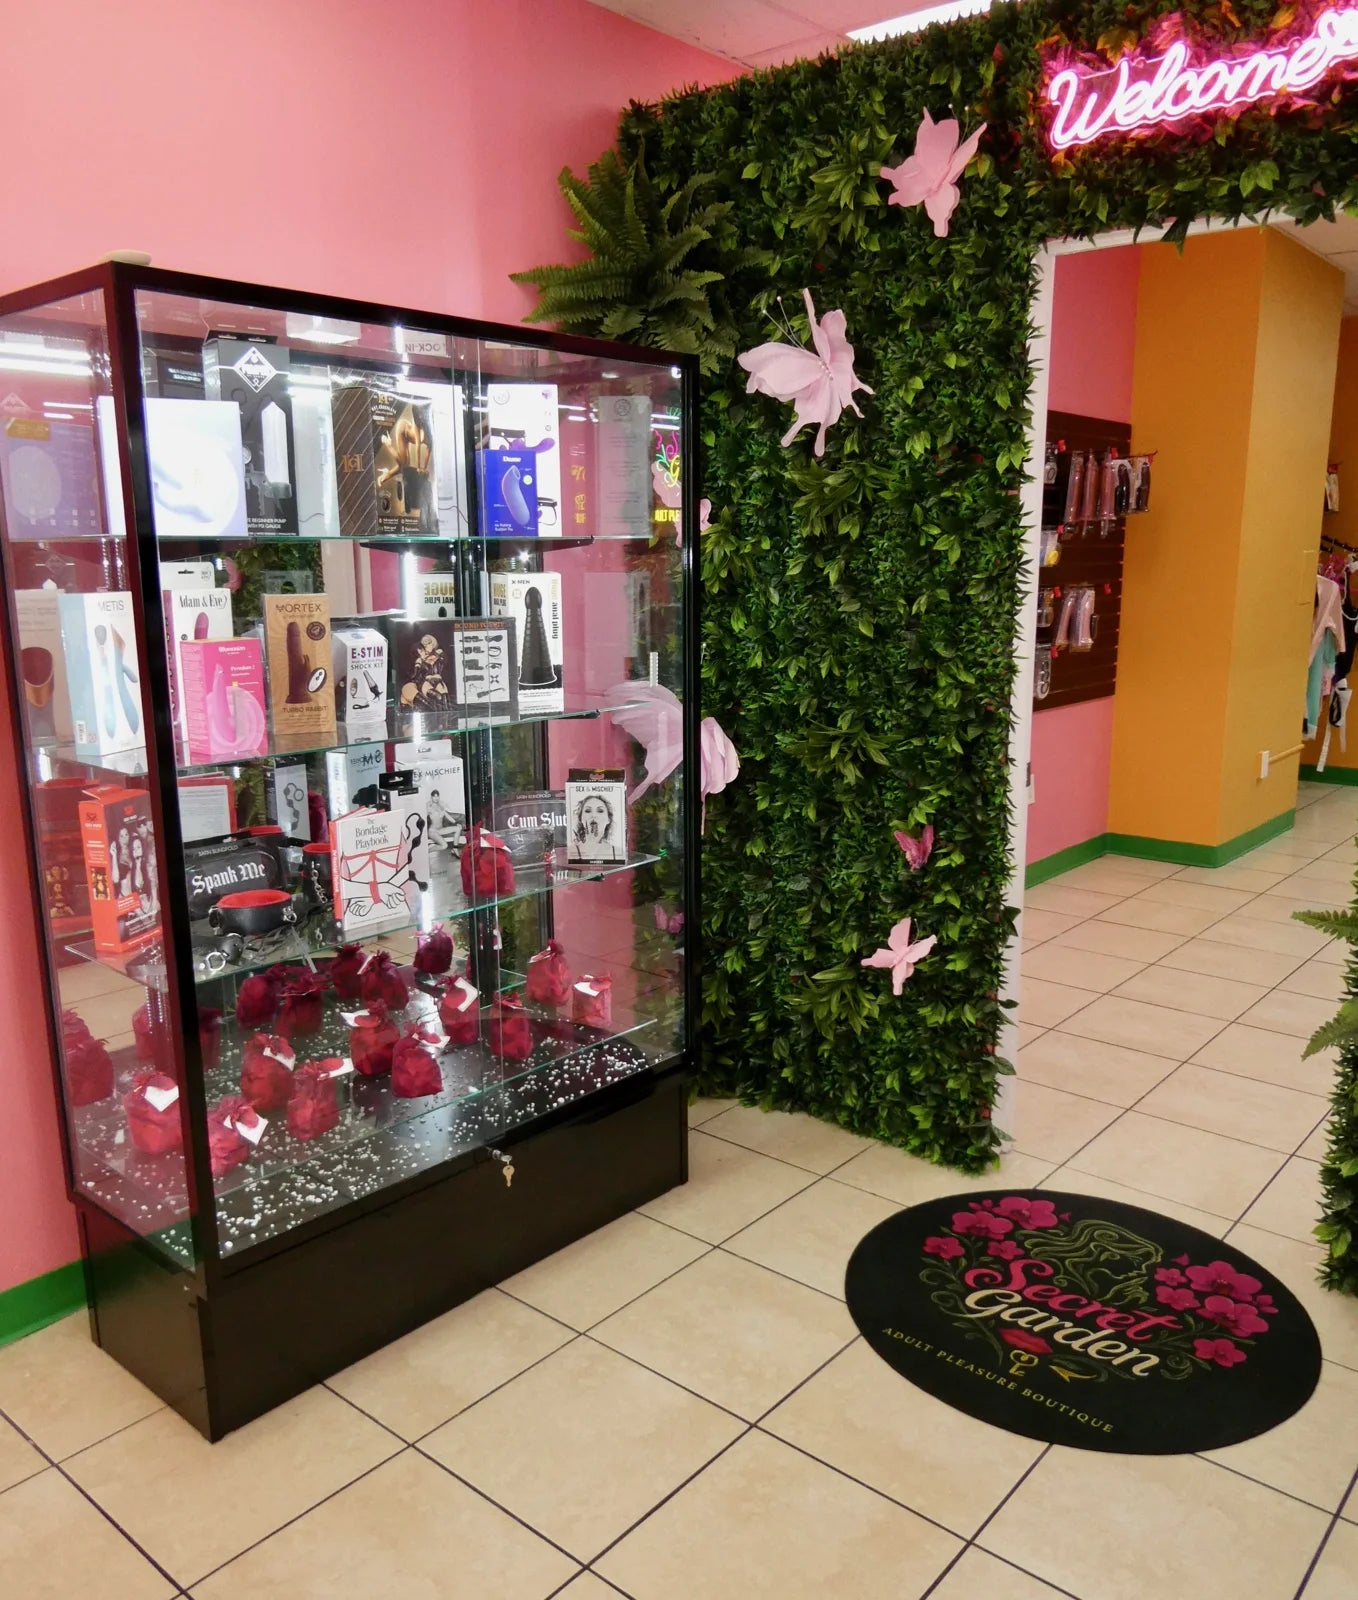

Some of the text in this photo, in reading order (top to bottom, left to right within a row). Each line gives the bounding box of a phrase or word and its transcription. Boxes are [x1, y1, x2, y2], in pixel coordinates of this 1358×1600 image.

[1050, 37, 1329, 144] Welcome
[179, 594, 200, 608] Adam
[209, 594, 224, 608] Eve
[351, 646, 384, 659] E-STIM
[425, 767, 461, 778] MISCHIEF
[575, 785, 585, 793] SEX
[507, 811, 567, 830] Cum Slut
[355, 824, 389, 838] Bondage
[355, 834, 389, 850] Playbook
[191, 862, 266, 897] Spank Me
[964, 1258, 1184, 1341] Secret
[965, 1289, 1162, 1378] Garden
[881, 1327, 1115, 1433] ADULT PLEASURE BOUTIQUE
